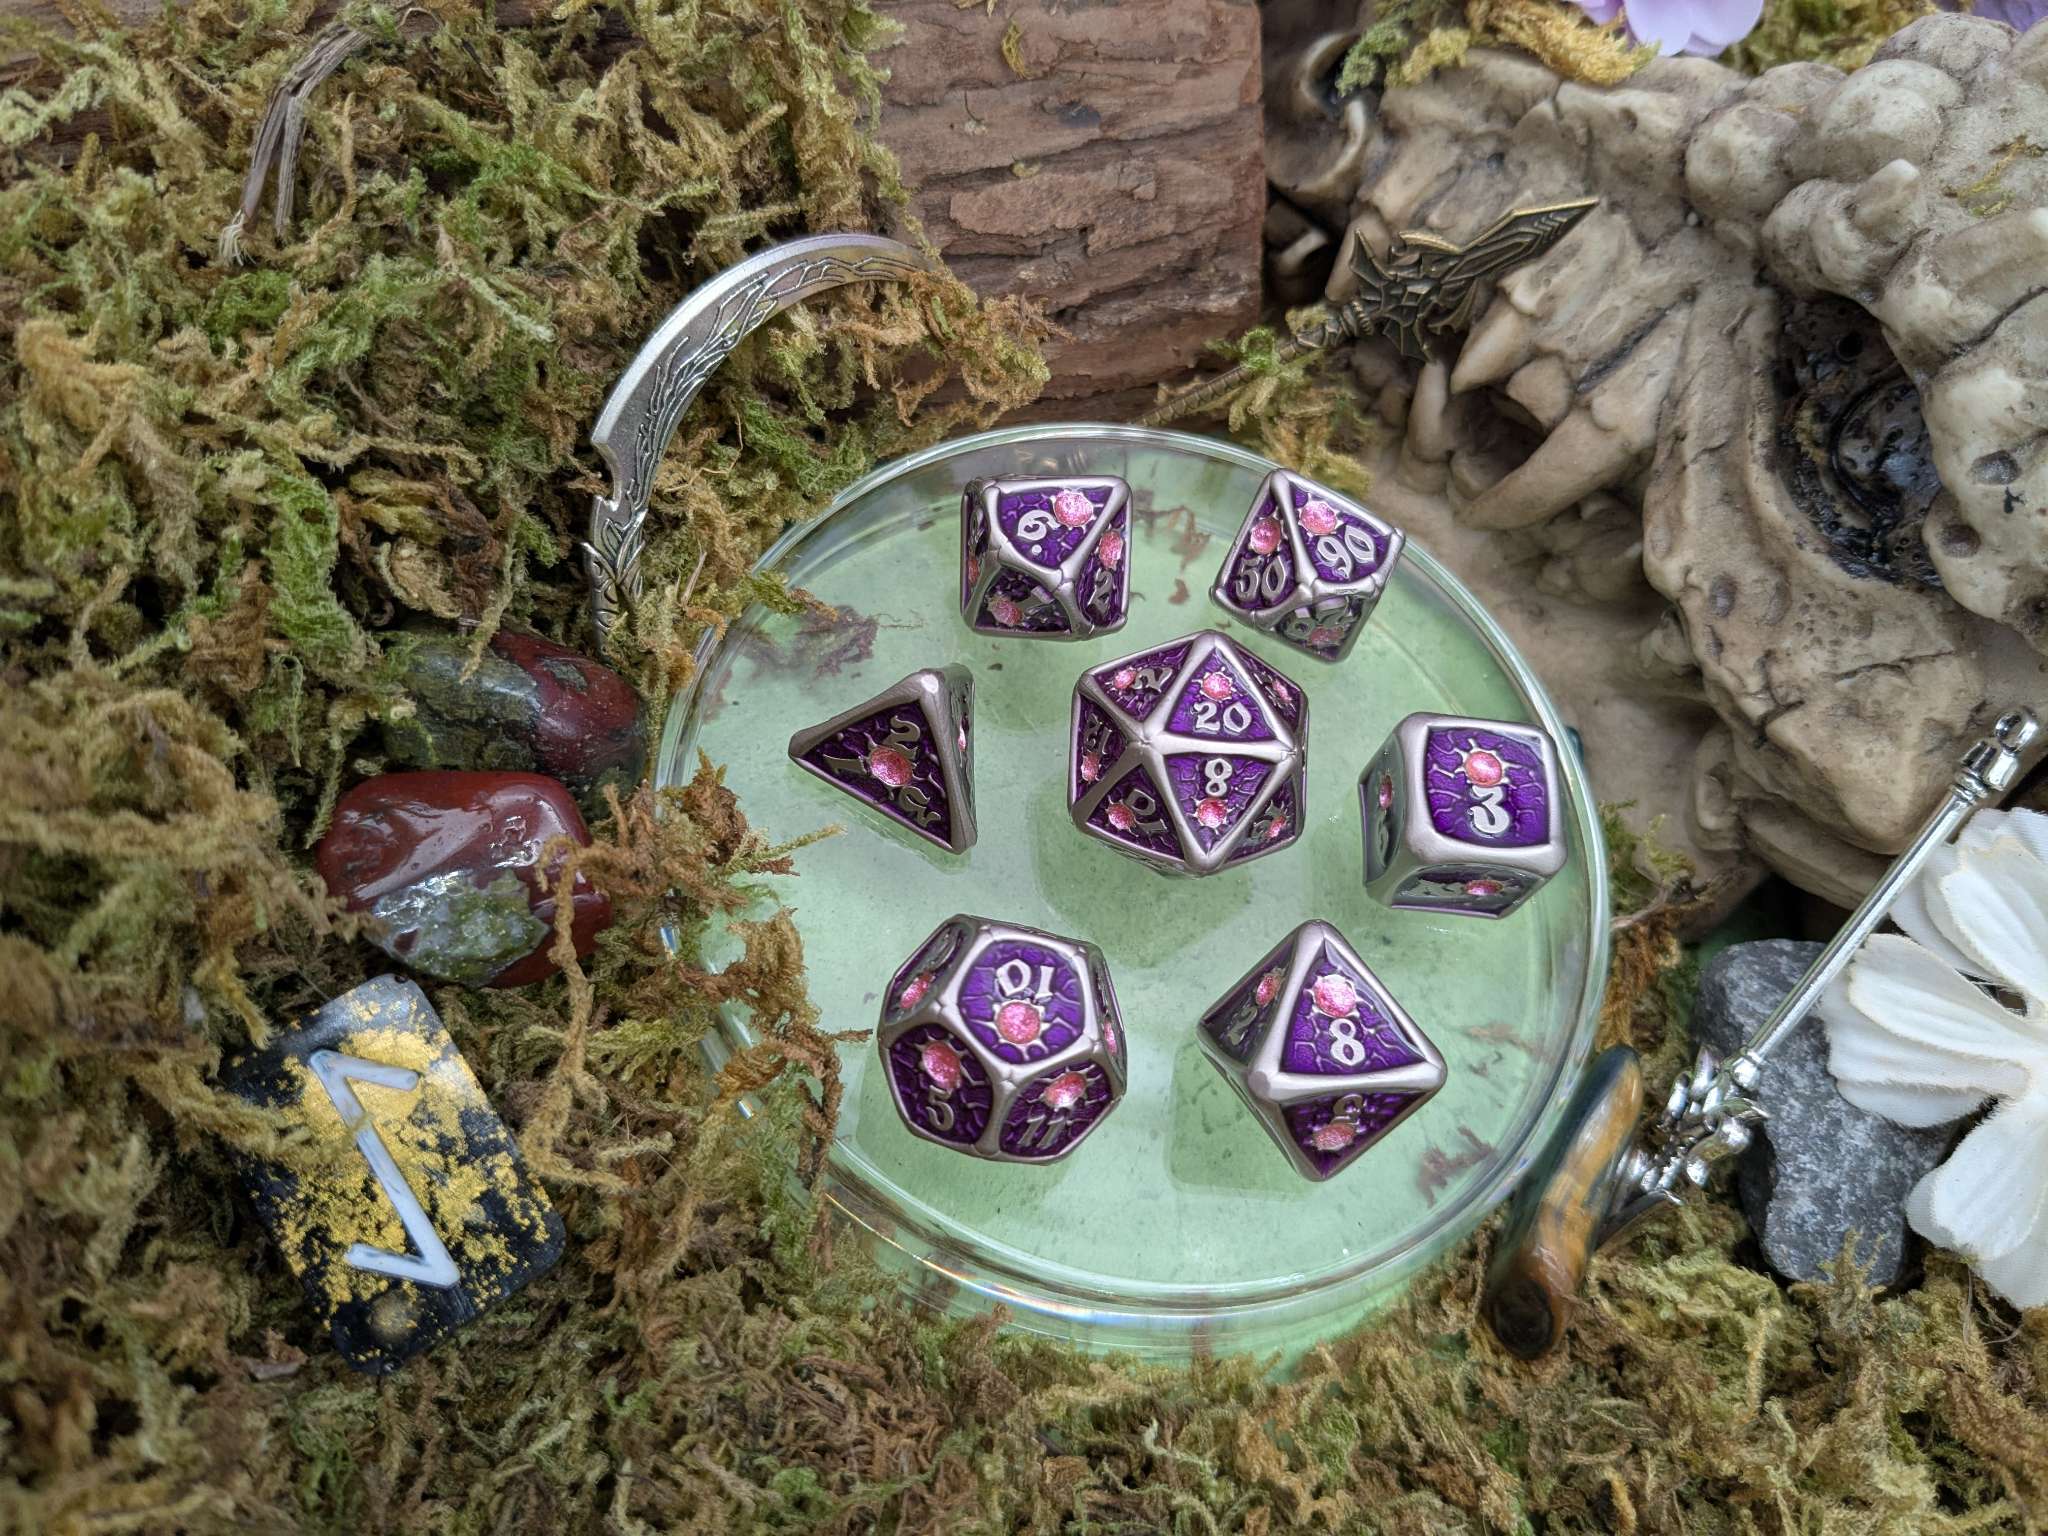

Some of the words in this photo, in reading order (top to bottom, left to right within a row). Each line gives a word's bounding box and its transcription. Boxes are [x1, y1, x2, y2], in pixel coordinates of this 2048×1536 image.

[1317, 524, 1375, 579] 90
[1235, 555, 1287, 601] 50
[1191, 702, 1251, 734] 20
[1204, 757, 1232, 797] 8
[1470, 785, 1511, 837] 3
[995, 958, 1055, 1000] 10
[1329, 1018, 1366, 1066] 8
[926, 1085, 955, 1131] 5
